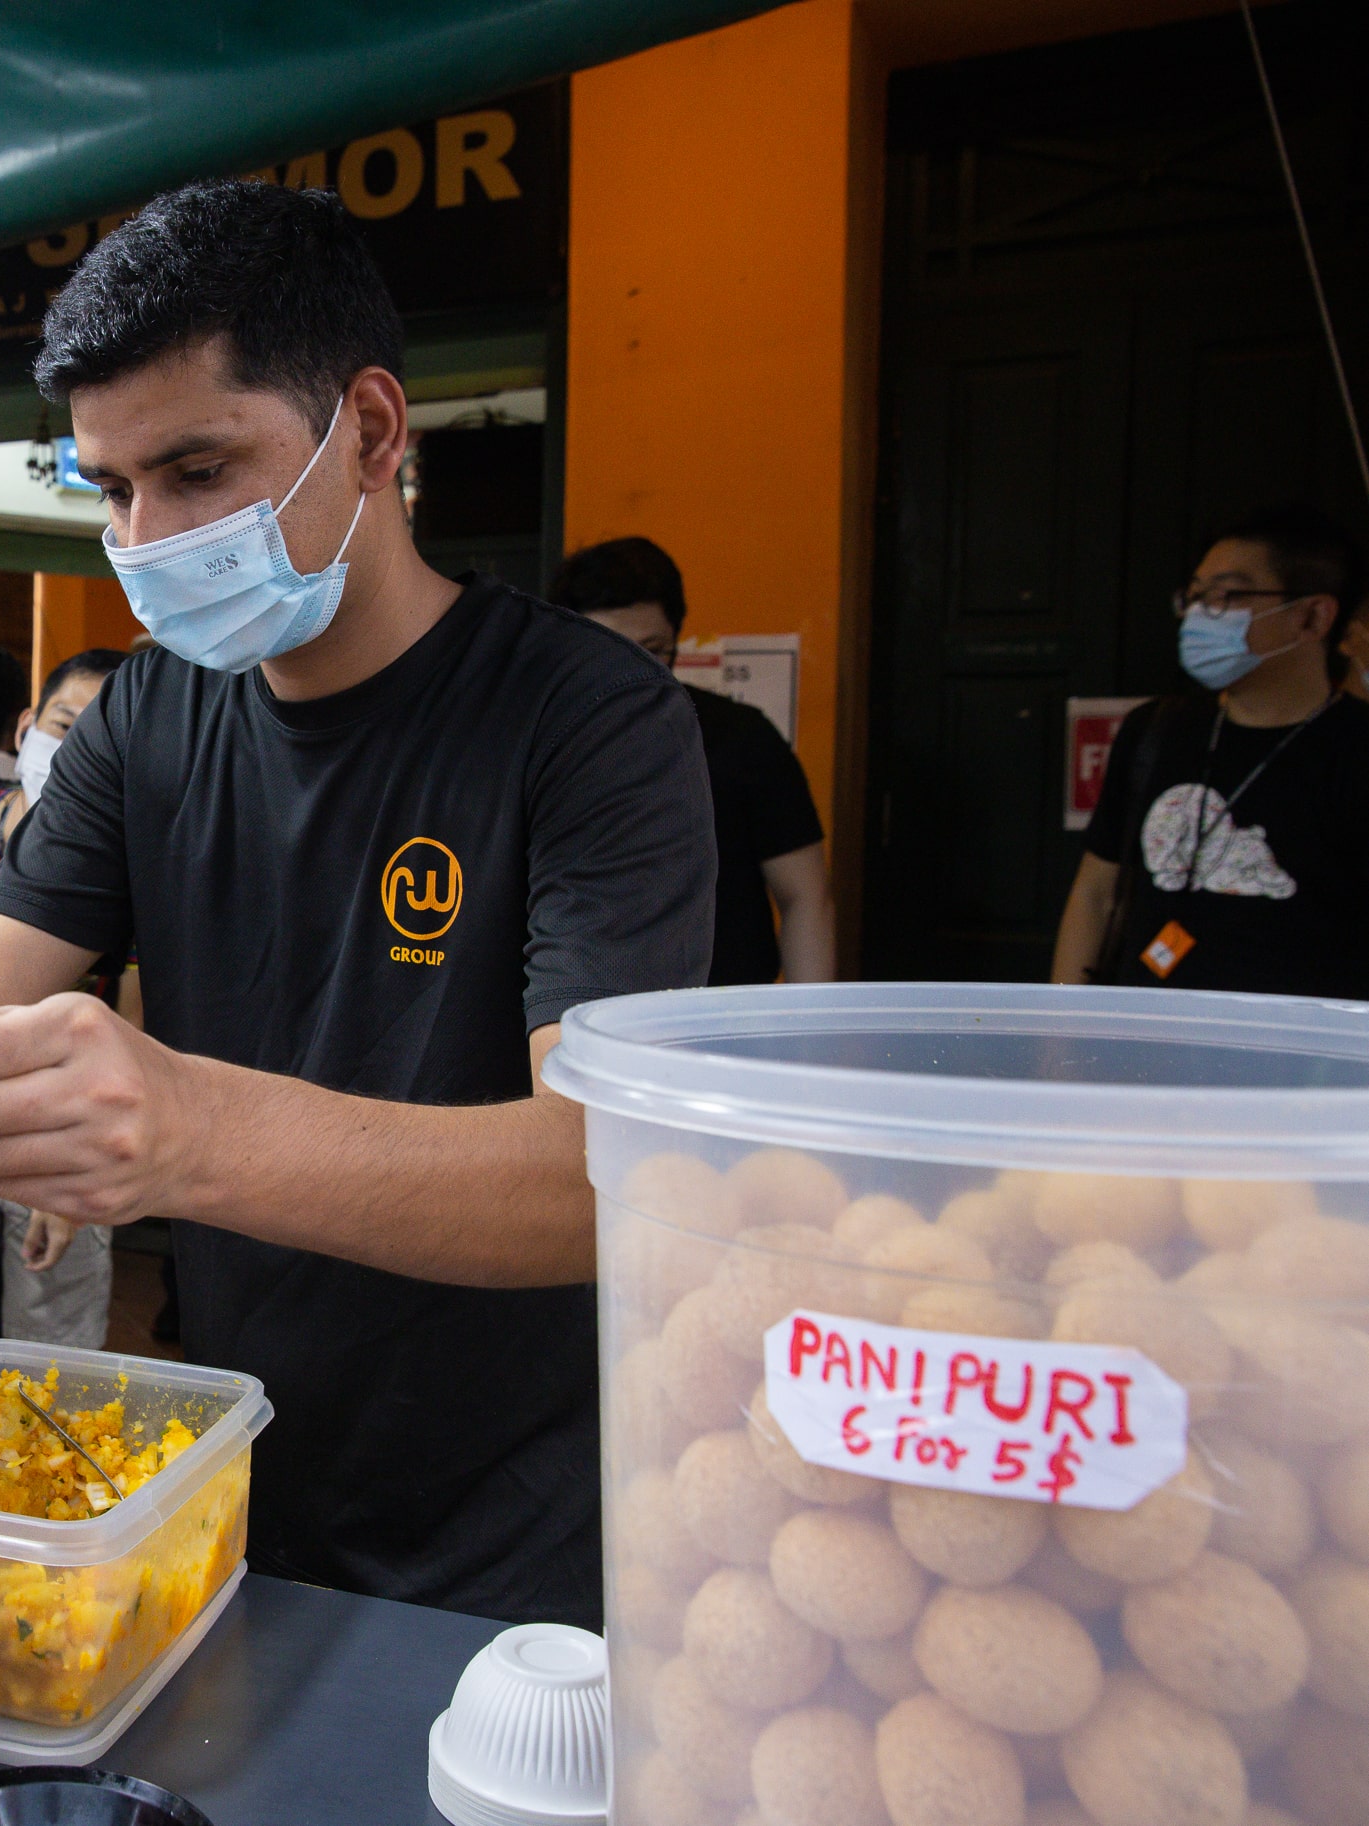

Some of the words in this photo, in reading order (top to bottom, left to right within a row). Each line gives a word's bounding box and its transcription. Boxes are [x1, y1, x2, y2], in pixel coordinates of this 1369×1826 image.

[390, 946, 445, 966] GROUP
[944, 1352, 1135, 1444] PURI
[841, 1405, 872, 1455] 6
